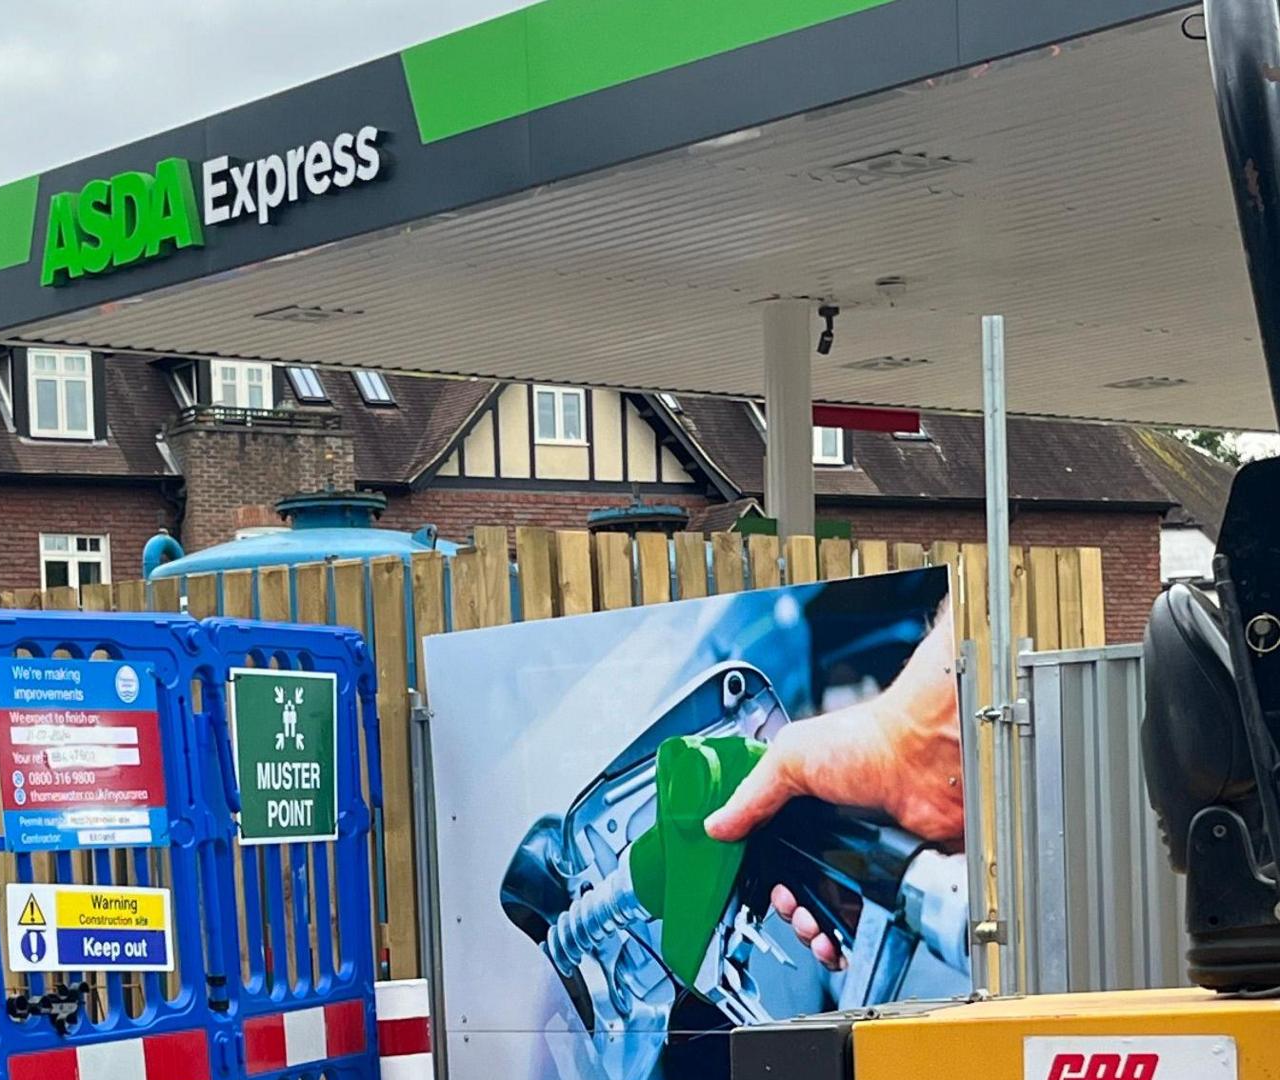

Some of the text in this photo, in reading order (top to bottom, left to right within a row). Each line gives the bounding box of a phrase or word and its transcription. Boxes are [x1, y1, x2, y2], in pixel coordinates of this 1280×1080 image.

[40, 126, 380, 286] ASDA Express
[12, 666, 81, 684] We're making
[14, 688, 84, 703] improvements
[29, 771, 95, 785] 0800 316 9800
[257, 762, 320, 790] MUSTER
[267, 800, 314, 827] POINT
[91, 895, 138, 914] Warning
[79, 914, 148, 927] Construction site
[83, 937, 148, 960] Keep out
